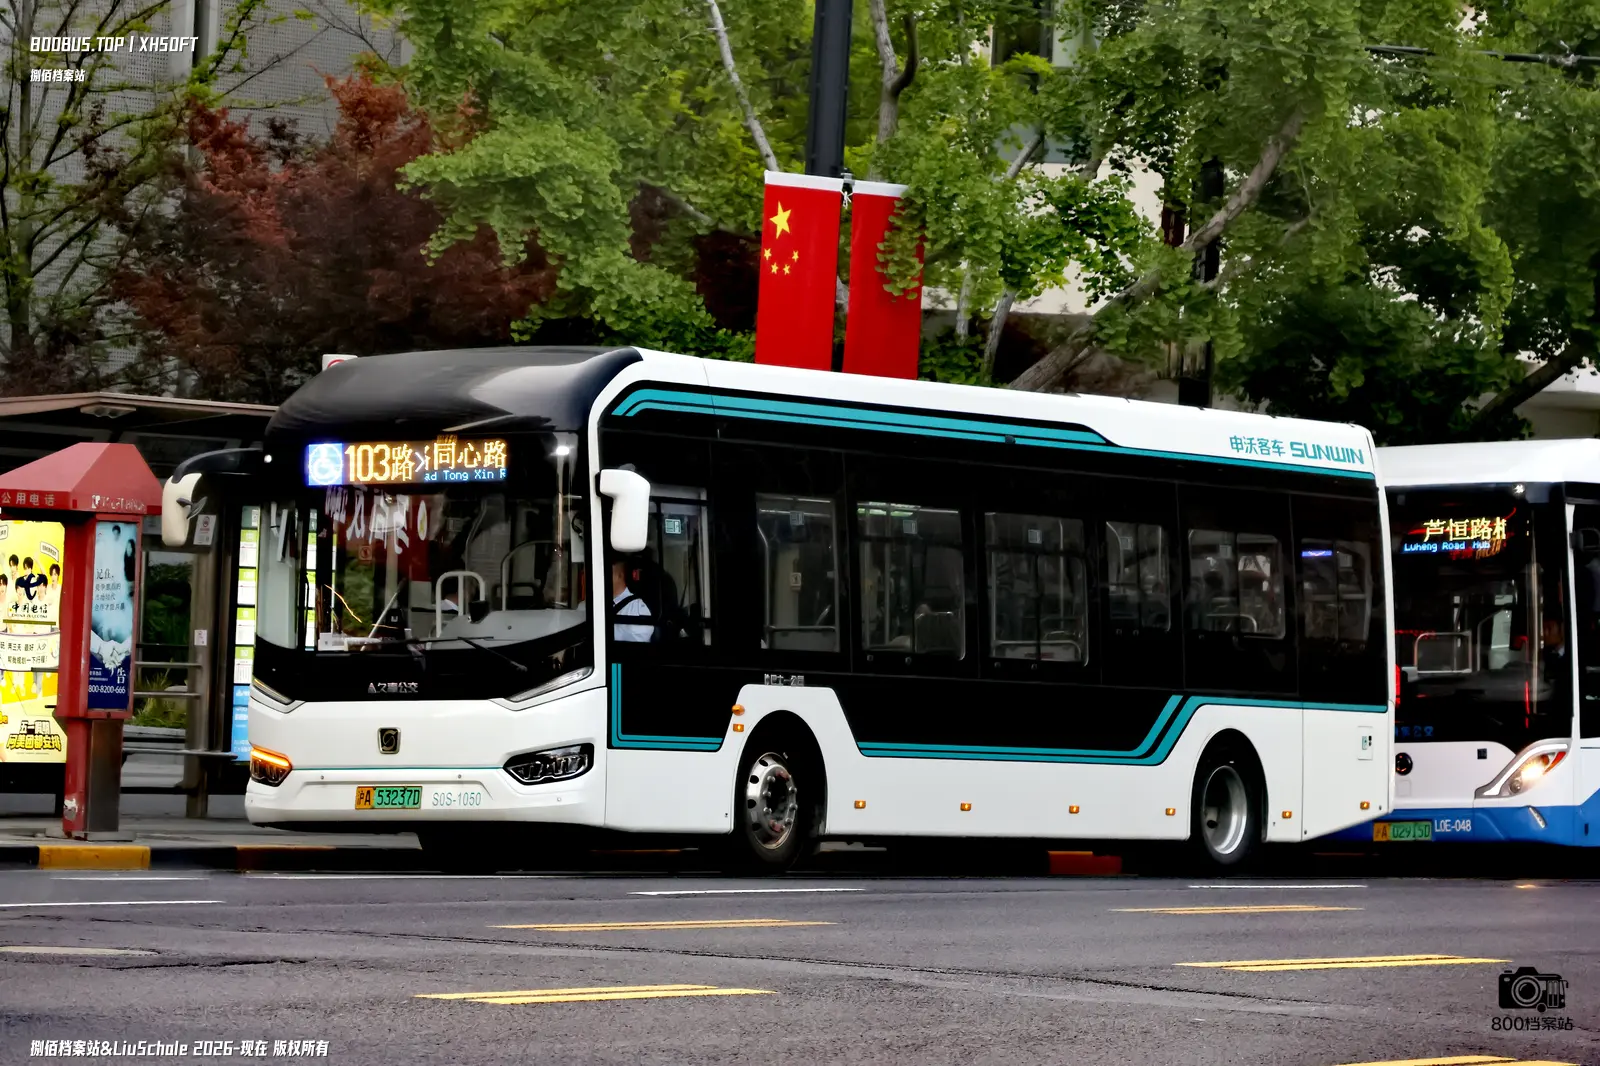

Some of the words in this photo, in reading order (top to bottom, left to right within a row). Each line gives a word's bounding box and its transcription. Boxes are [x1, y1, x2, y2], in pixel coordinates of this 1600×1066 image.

[1229, 435, 1286, 457] 申沃客车
[1289, 441, 1365, 465] SUNWIN
[344, 443, 415, 482] 103路
[443, 470, 468, 481] Tong
[474, 469, 494, 480] Xin
[1, 492, 55, 506] 公用电话
[1403, 542, 1437, 552] Luheng
[1442, 541, 1466, 550] Road
[1472, 540, 1491, 549] Hub
[12, 602, 48, 613] 中国电信
[376, 789, 421, 806] 53237D
